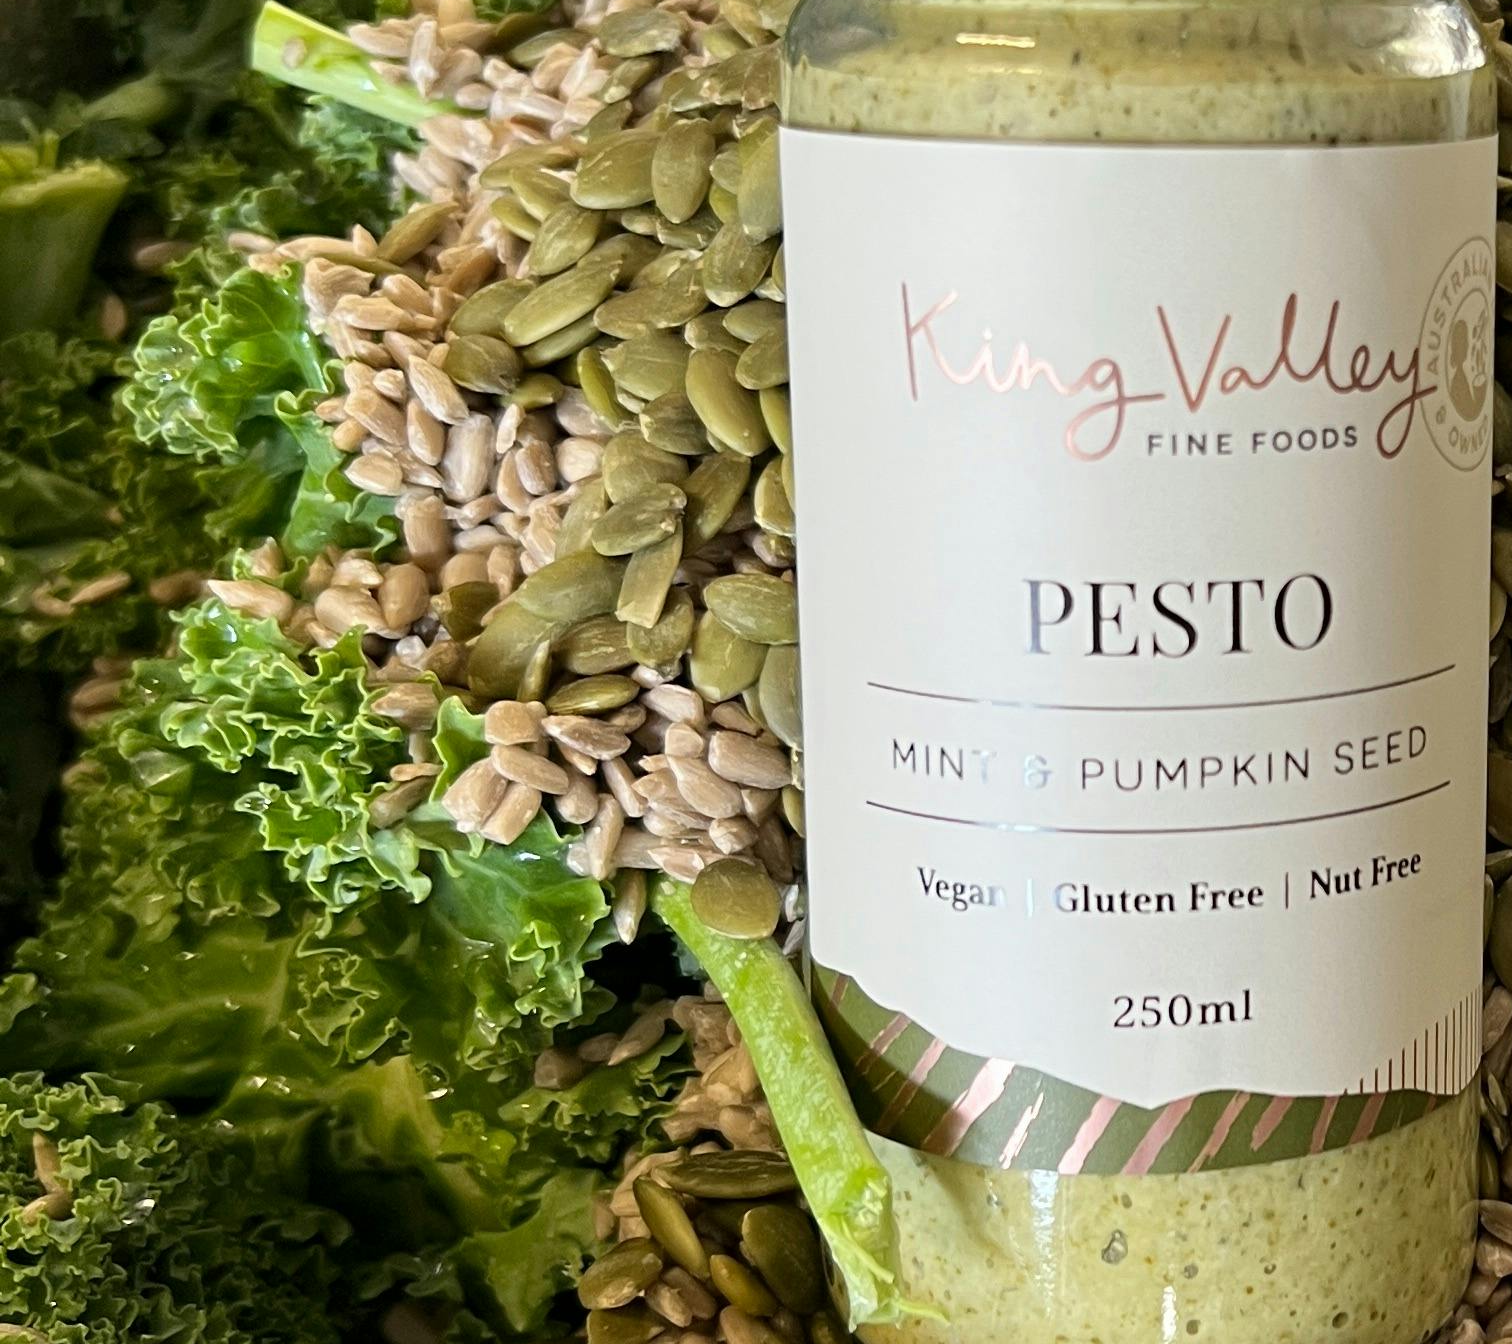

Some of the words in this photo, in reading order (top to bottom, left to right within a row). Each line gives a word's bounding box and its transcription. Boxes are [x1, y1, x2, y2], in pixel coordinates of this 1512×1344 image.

[900, 280, 1164, 462] King
[1156, 292, 1438, 460] Valley
[1146, 433, 1234, 457] FINE
[1251, 425, 1359, 455] FOODS
[1022, 572, 1335, 658] PESTO
[890, 737, 998, 785] MINT
[1022, 753, 1055, 791] &
[1080, 747, 1311, 793] PUMPKIN
[1333, 725, 1428, 777] SEED
[916, 866, 1008, 912] Vegan
[1053, 881, 1176, 914] Gluten
[1188, 880, 1265, 912] Free
[1308, 866, 1363, 901] Nut
[1370, 851, 1422, 887] Free
[1112, 989, 1253, 1029] 250ml
